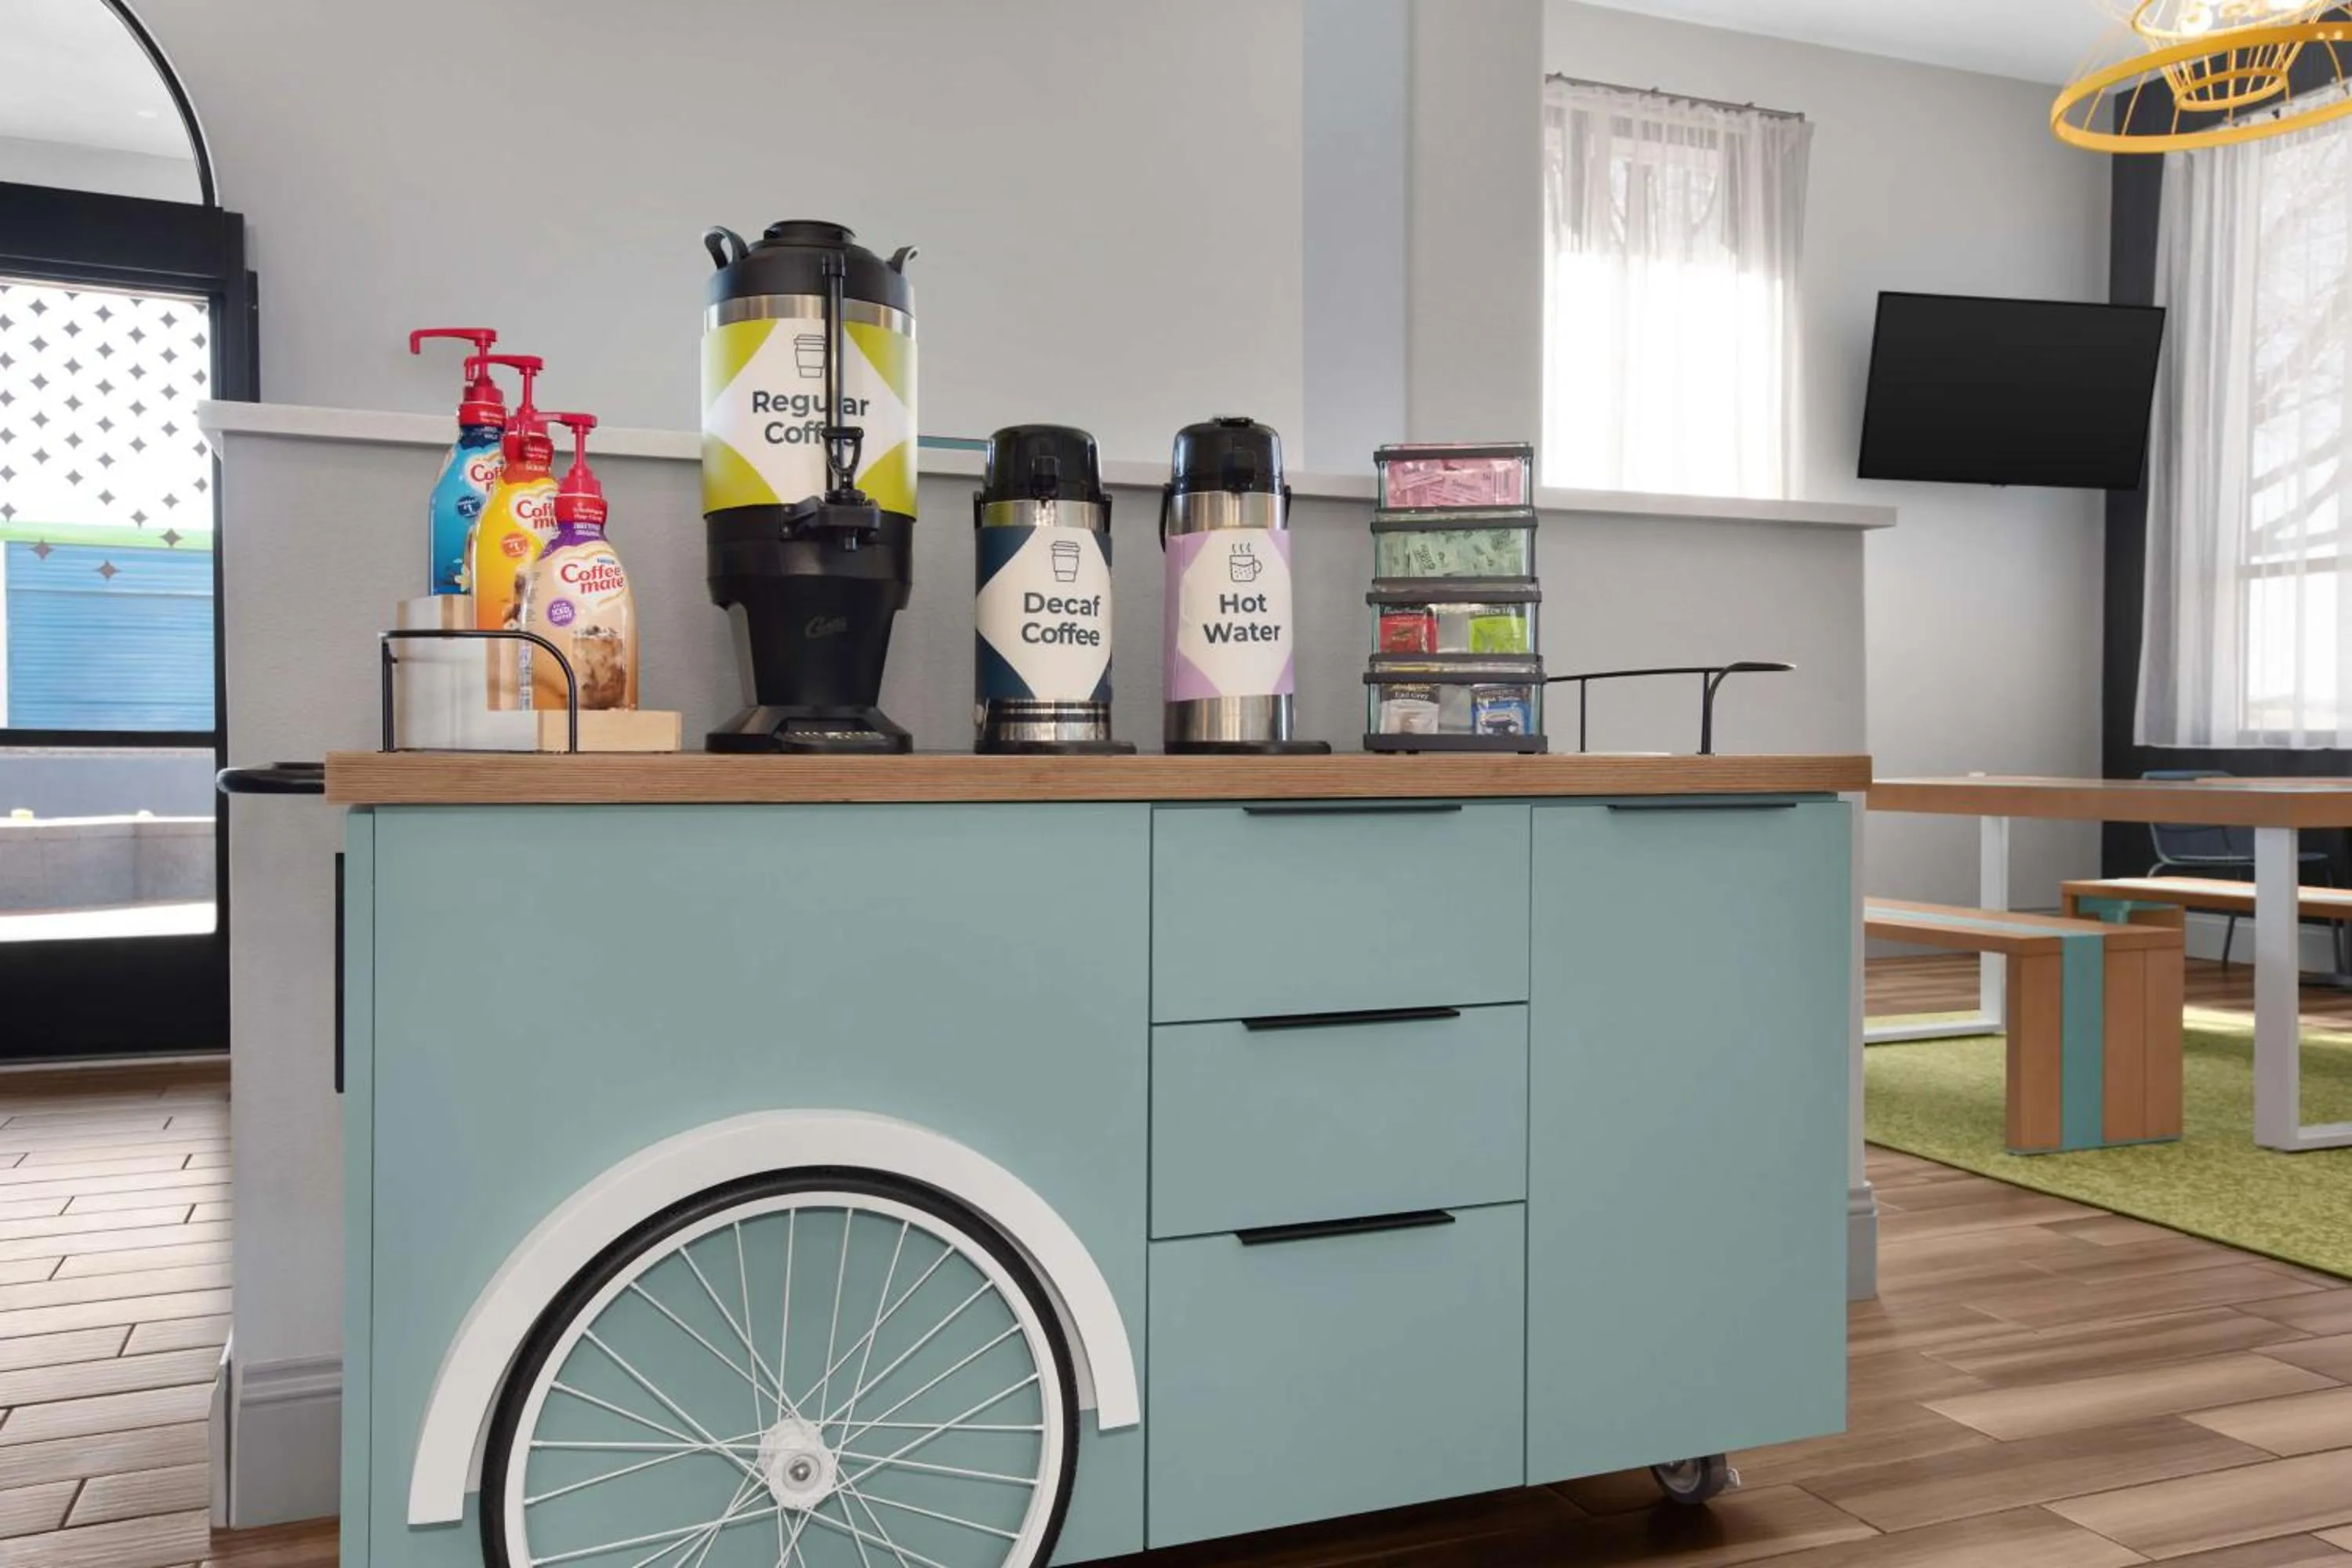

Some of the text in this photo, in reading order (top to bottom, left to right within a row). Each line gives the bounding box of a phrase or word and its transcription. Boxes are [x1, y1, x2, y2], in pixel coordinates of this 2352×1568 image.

[752, 390, 869, 417] Reguar
[764, 421, 856, 445] Coff
[470, 463, 502, 481] Coff
[516, 499, 553, 518] Coff
[561, 564, 622, 583] Coffee
[580, 575, 625, 594] mate
[1023, 592, 1101, 617] Decaf
[1218, 593, 1268, 614] Hot
[1021, 622, 1101, 646] Coffee
[1203, 623, 1281, 644] Water
